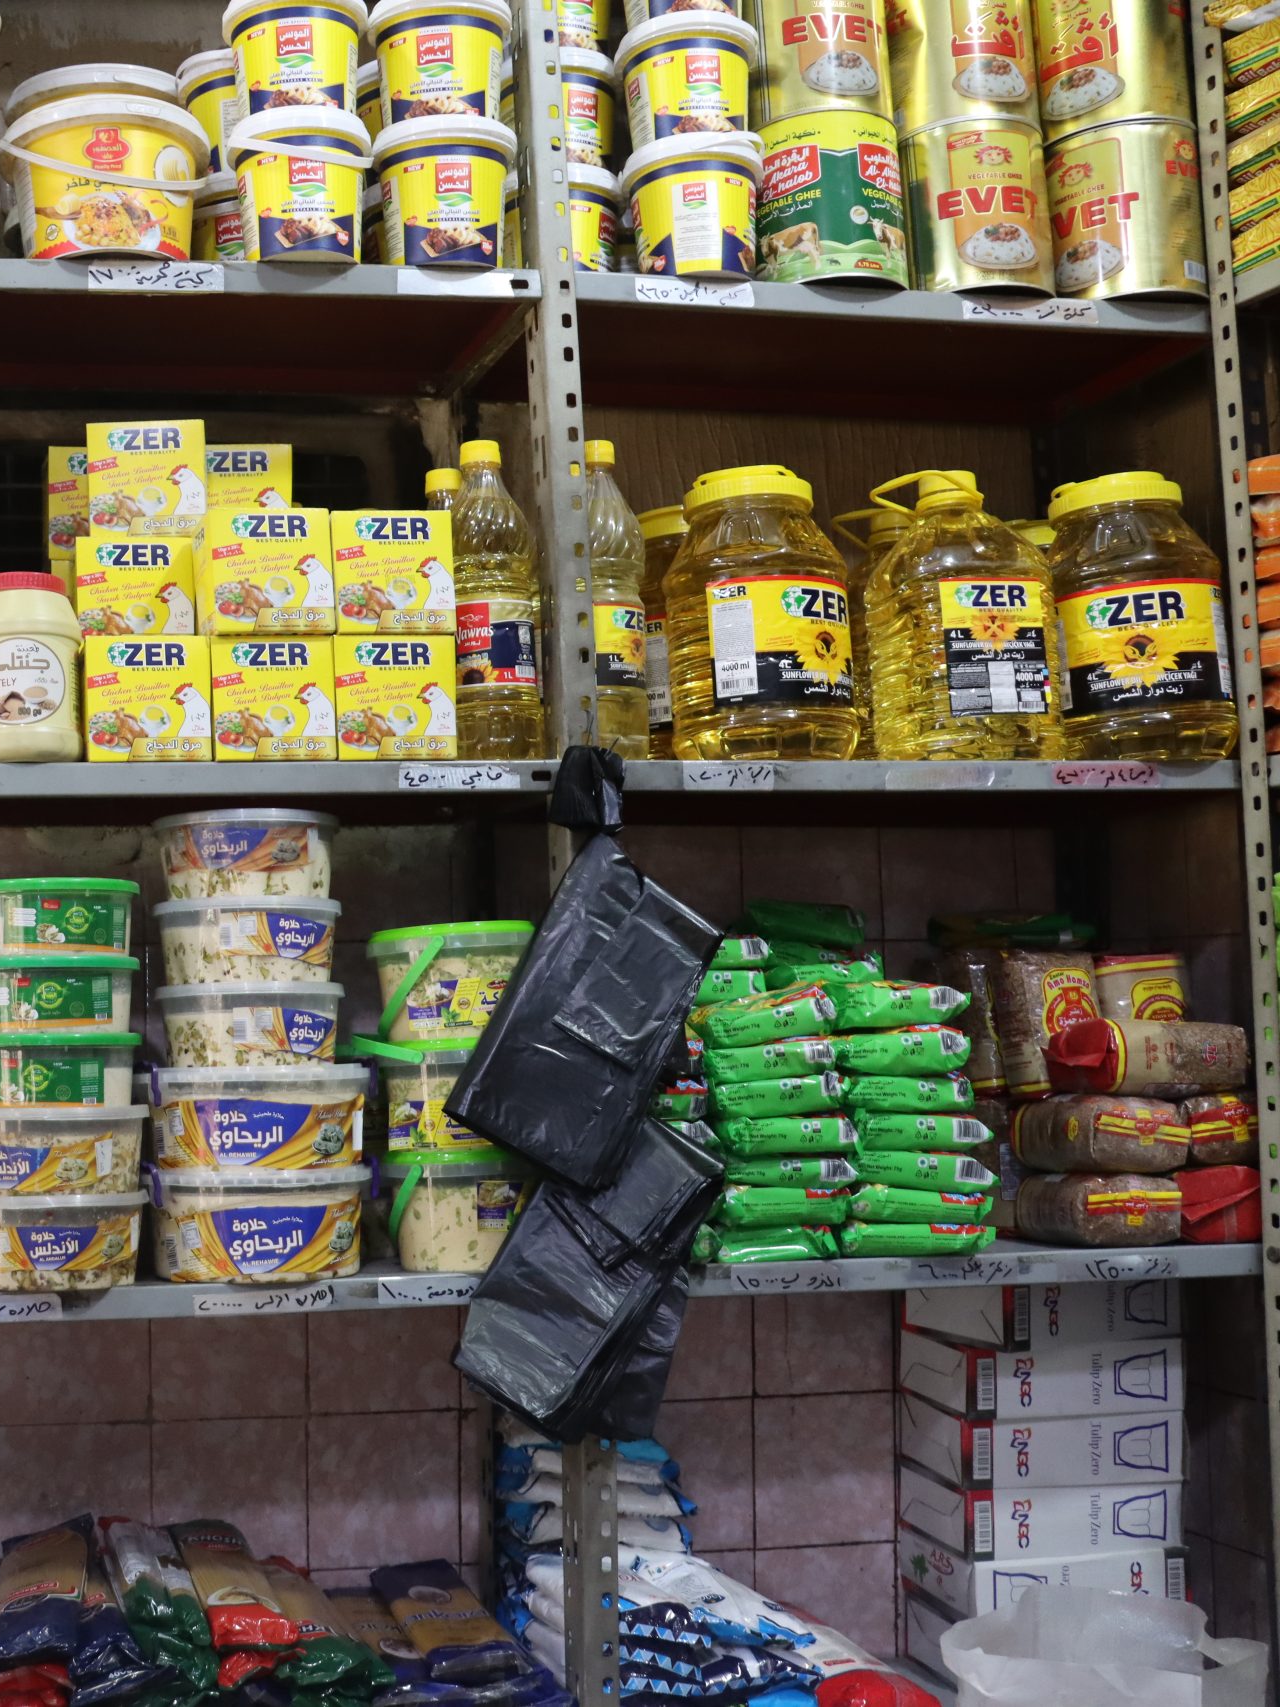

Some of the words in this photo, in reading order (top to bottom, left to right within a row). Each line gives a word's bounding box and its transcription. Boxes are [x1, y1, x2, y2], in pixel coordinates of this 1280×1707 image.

[279, 28, 310, 41] الموسى
[419, 36, 451, 49] الموسى
[279, 41, 310, 54] الحسن
[419, 49, 451, 63] الحسن
[688, 58, 719, 70] الموسى
[688, 70, 719, 83] الحسن
[438, 166, 470, 179] الموسى
[438, 179, 470, 192] الحسن
[795, 189, 822, 204] GHEE
[1051, 192, 1140, 240] VET
[124, 427, 181, 450] ZER
[213, 450, 269, 472] ZER
[143, 516, 174, 532] الدجاج
[177, 517, 197, 530] مرق
[248, 514, 308, 538] ZER
[371, 516, 431, 541] ZER
[113, 544, 170, 567] ZER
[971, 584, 1028, 608] ZER
[801, 588, 848, 626] ZER
[1108, 590, 1186, 628] ZER
[393, 611, 425, 627] الدجاج
[427, 613, 448, 625] مرق
[125, 643, 185, 666] ZER
[249, 642, 309, 666] ZER
[372, 642, 432, 667] ZER
[721, 662, 738, 672] 4000
[740, 661, 750, 670] ml
[101, 686, 132, 698] Chicken
[1090, 678, 1131, 692] SUNFLOWER
[146, 739, 178, 753] الدجاج
[183, 741, 202, 752] مرق
[271, 739, 303, 753] الدجاج
[307, 740, 326, 752] مرق
[276, 930, 315, 945] الريحاوي
[213, 1110, 248, 1126] حلاوة
[209, 1126, 283, 1150] الريحاوي
[232, 1219, 268, 1235] حلاوة
[30, 1241, 79, 1259] الأندلس
[229, 1230, 303, 1258] الريحاوي
[1089, 1353, 1103, 1379] Tulip
[1090, 1380, 1102, 1405] Zero
[1089, 1423, 1103, 1449] Tulip
[1090, 1450, 1102, 1475] Zero
[1089, 1494, 1103, 1520] Tulip
[1090, 1521, 1102, 1546] Zero
